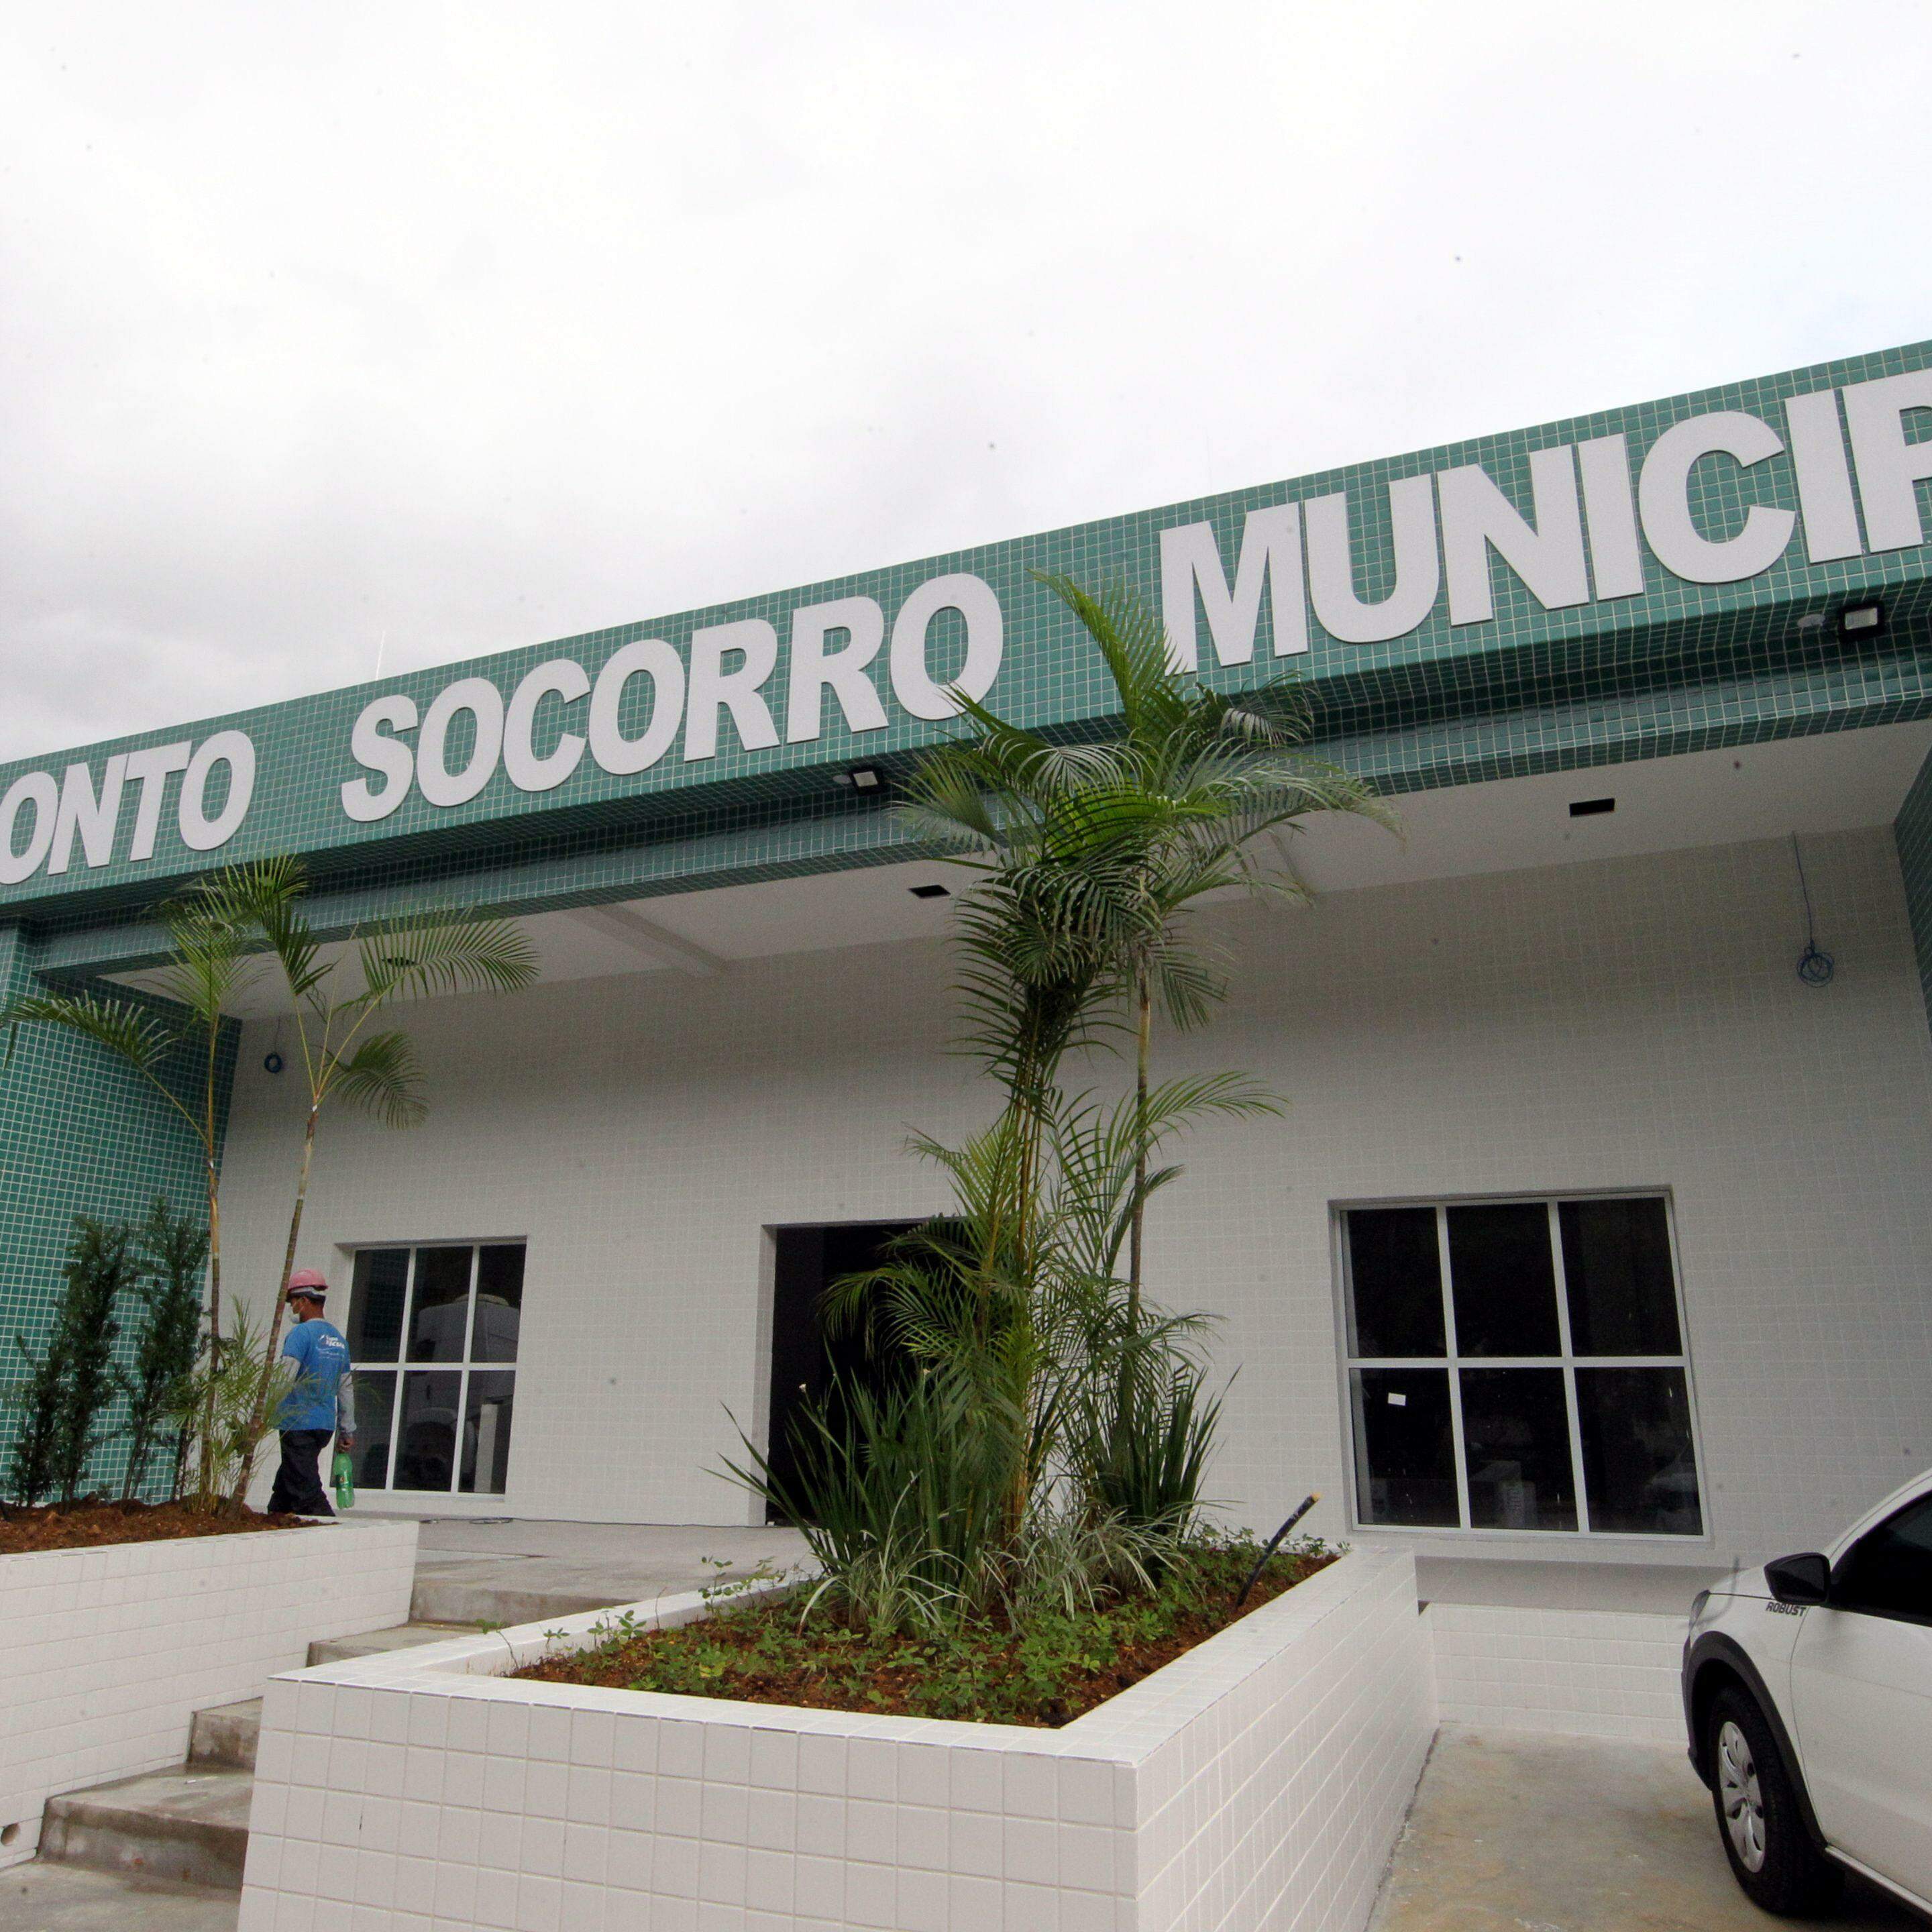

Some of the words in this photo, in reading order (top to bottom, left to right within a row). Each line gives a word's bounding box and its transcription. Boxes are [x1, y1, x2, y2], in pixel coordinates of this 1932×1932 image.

[0, 730, 256, 885] ONTO
[341, 573, 1004, 822] SOCORRO
[1766, 1601, 1807, 1617] ROBUST
